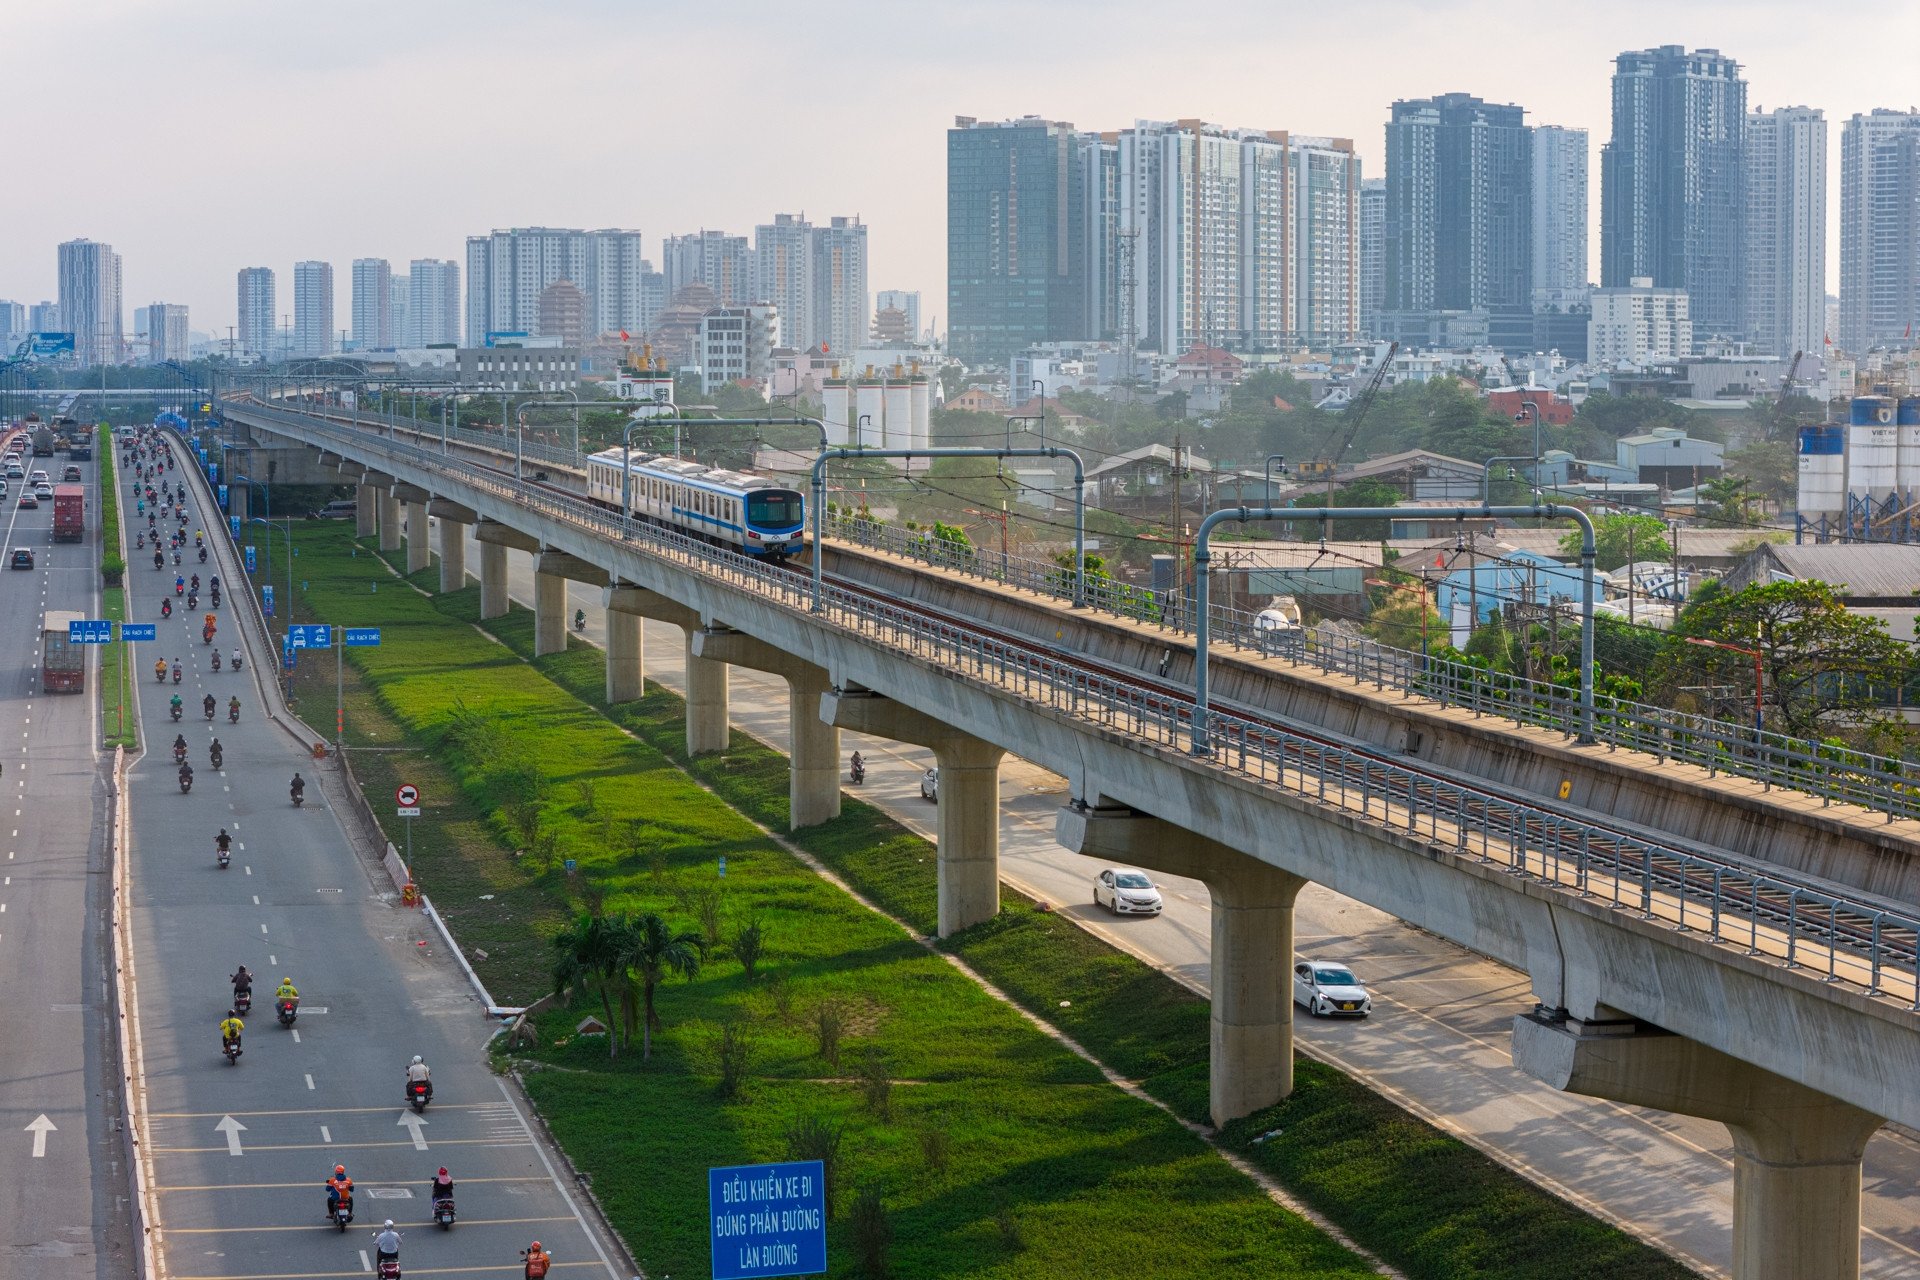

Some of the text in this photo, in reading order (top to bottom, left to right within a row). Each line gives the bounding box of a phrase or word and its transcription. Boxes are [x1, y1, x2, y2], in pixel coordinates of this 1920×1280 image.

[722, 1169, 812, 1204] ĐIỀU KHIỂN XE ĐI
[716, 1204, 820, 1238] ĐÚNG PHẦN ĐƯỜNG
[739, 1239, 798, 1269] LÀN ĐƯỜNG
